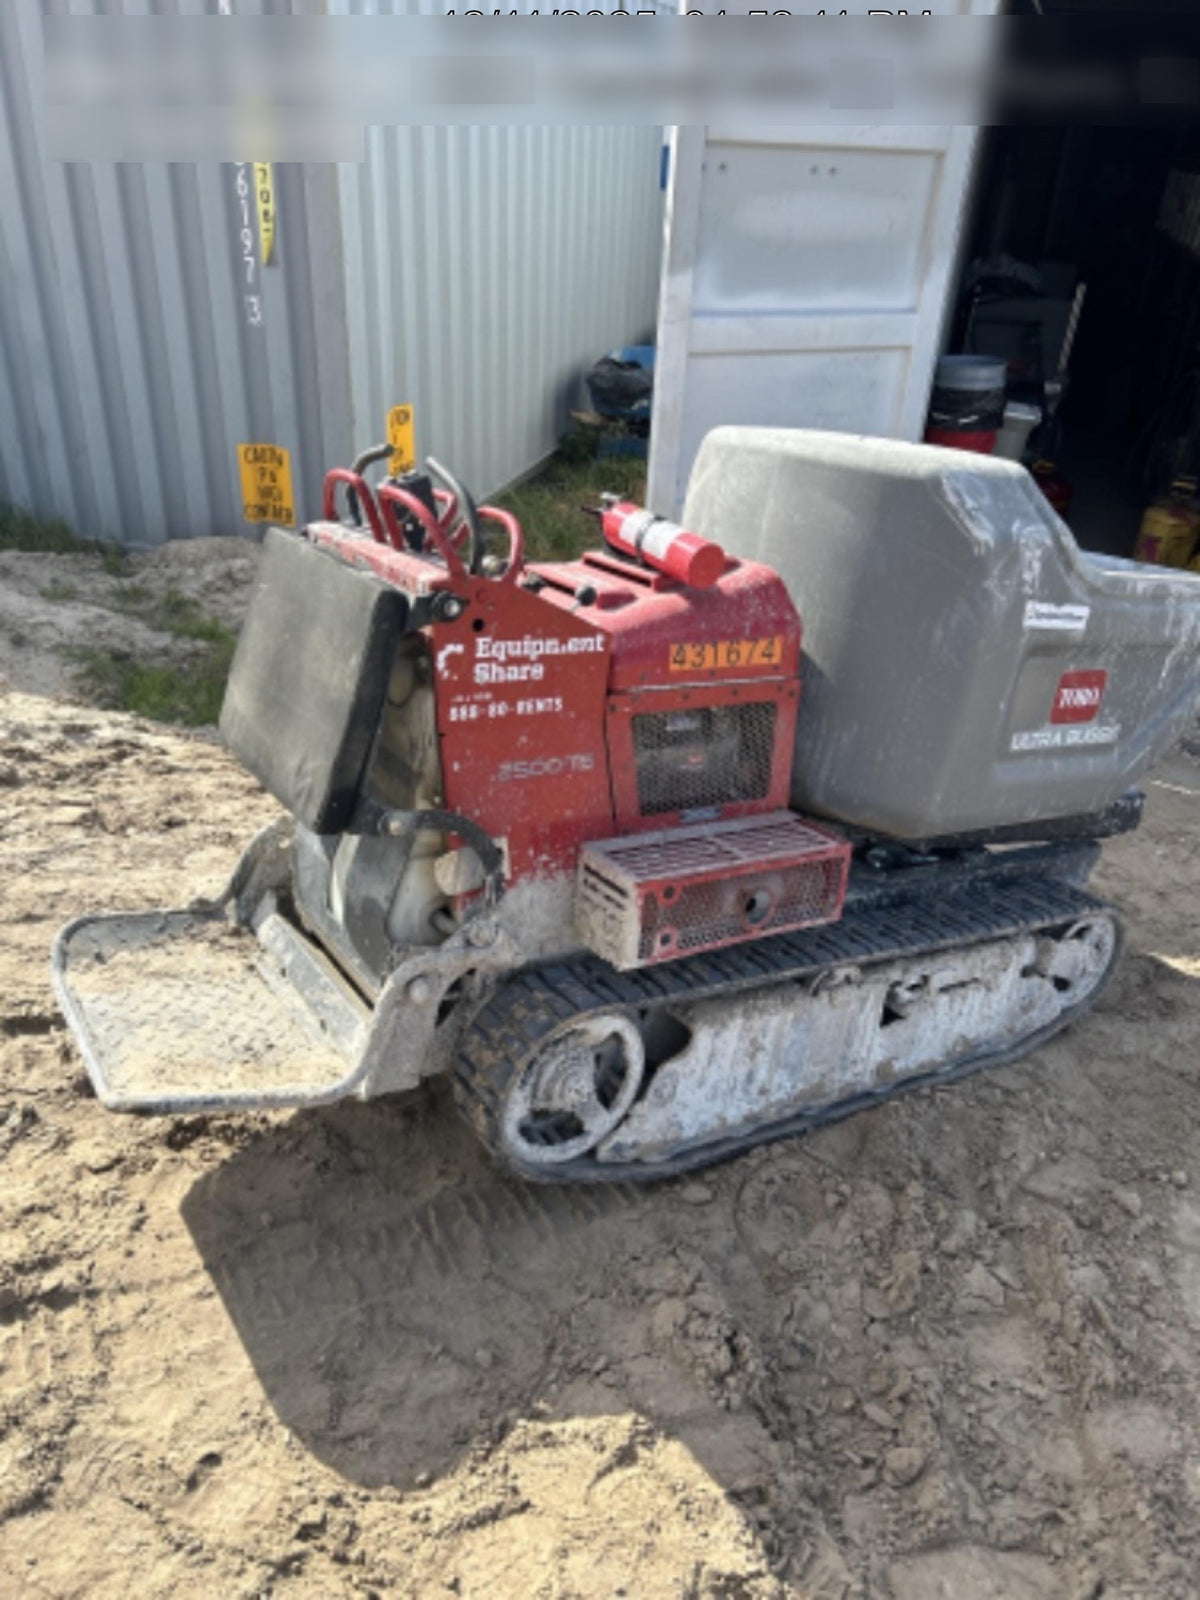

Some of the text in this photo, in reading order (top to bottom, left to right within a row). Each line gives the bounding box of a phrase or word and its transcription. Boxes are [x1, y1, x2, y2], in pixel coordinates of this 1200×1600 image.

[671, 636, 777, 669] 431674
[474, 662, 545, 685] Share
[1009, 730, 1062, 751] ULTRA
